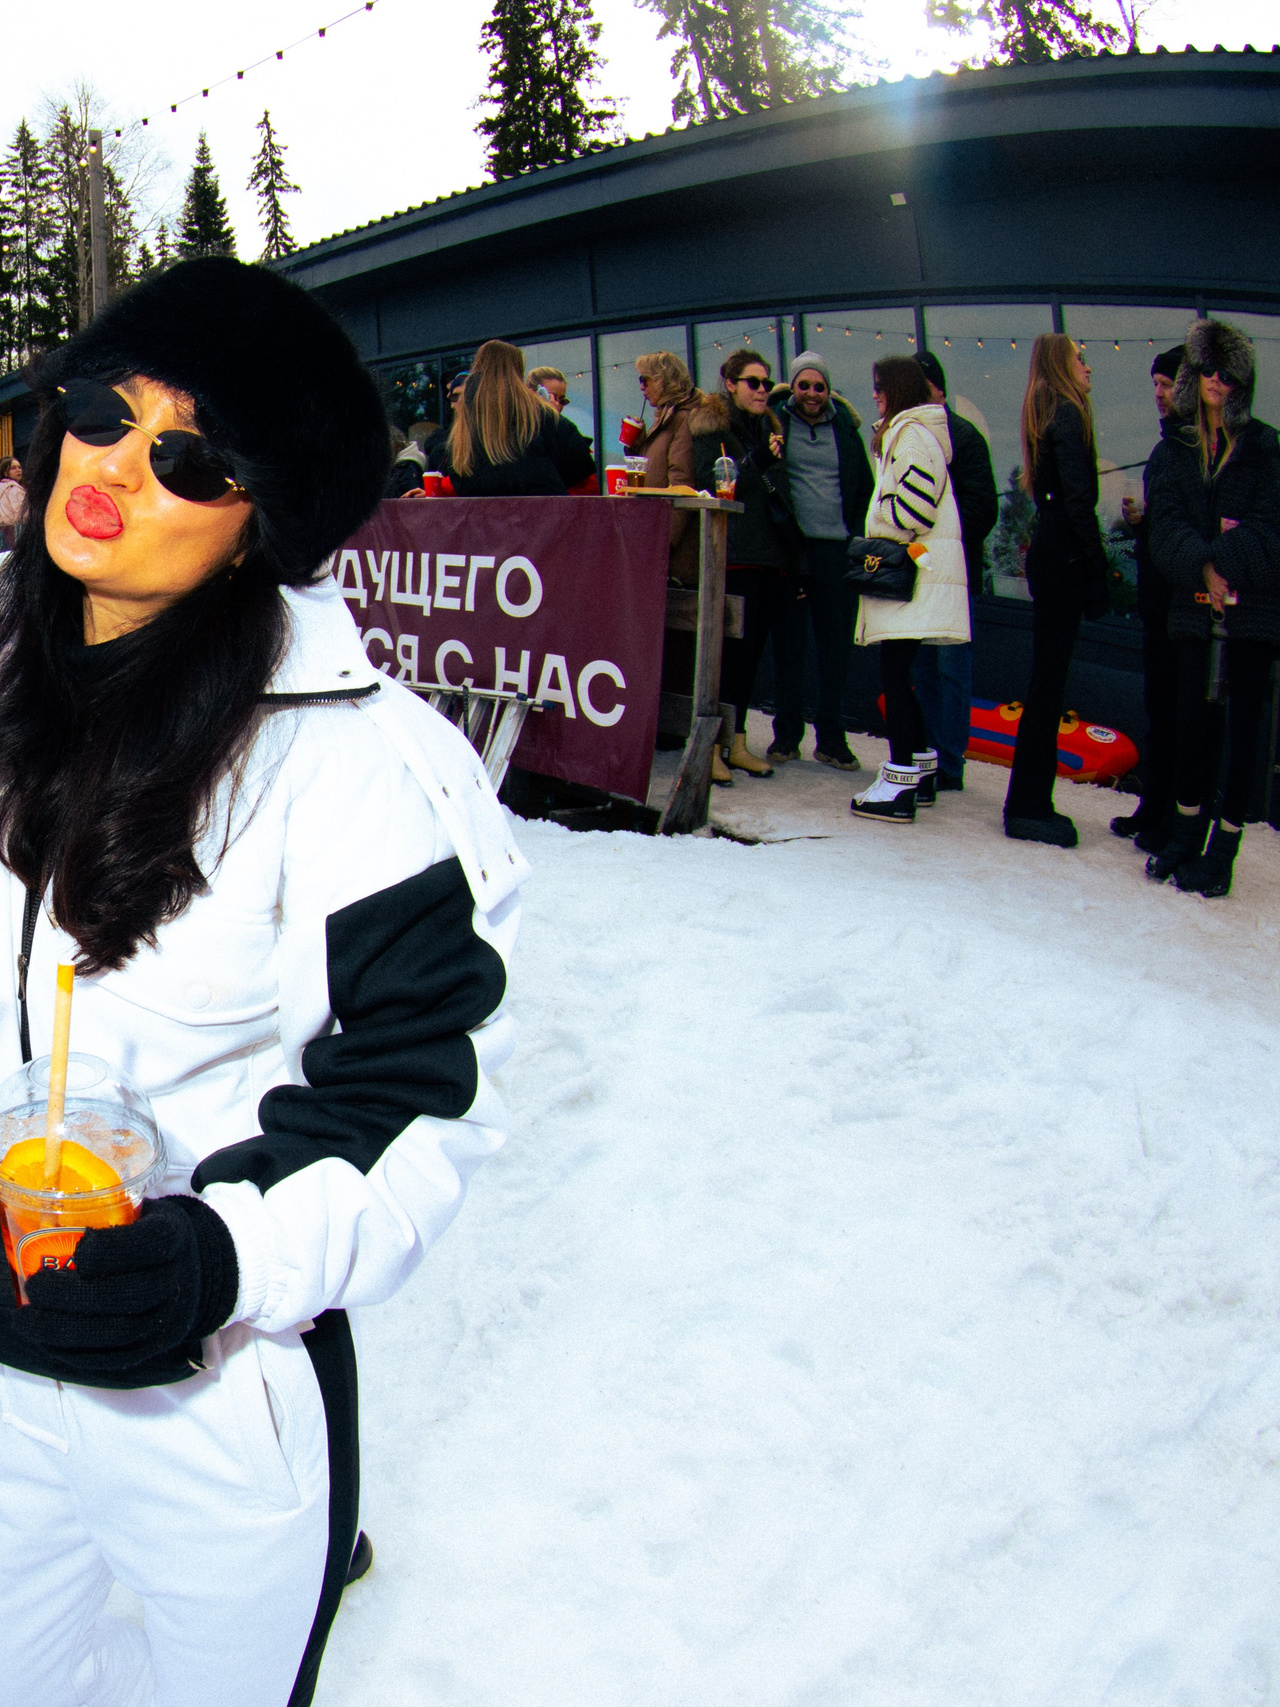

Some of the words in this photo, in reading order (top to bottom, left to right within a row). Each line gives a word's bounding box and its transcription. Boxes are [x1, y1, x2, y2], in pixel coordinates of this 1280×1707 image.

[329, 549, 543, 617] ДУЩЕГО
[357, 627, 418, 683] СЯ
[435, 639, 474, 688] С
[495, 646, 626, 727] НАС
[42, 1256, 76, 1271] BA
